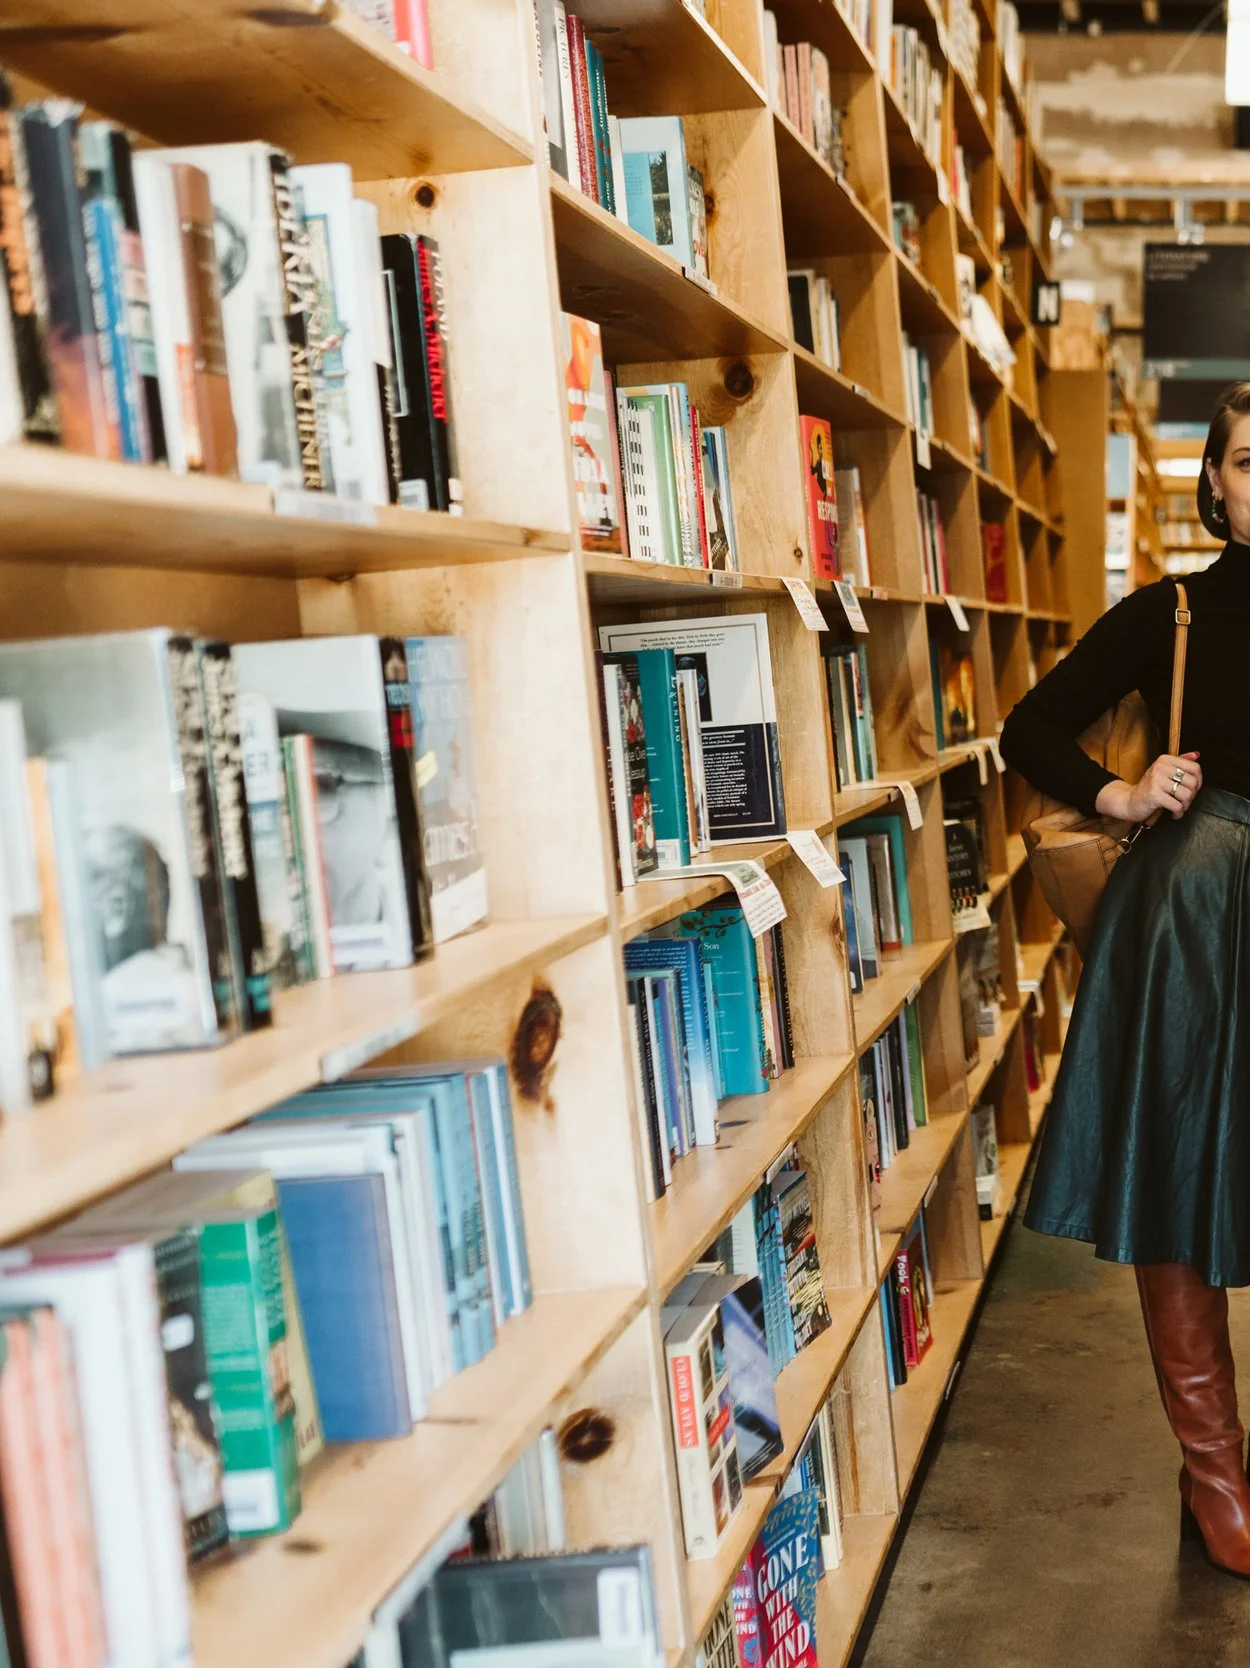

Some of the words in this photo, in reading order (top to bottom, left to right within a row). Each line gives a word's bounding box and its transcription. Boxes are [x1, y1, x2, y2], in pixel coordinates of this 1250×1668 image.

[555, 17, 574, 79] PICTURES
[590, 68, 609, 130] Monogamy
[422, 305, 439, 328] A.
[429, 251, 452, 342] POLAND
[1039, 287, 1058, 321] N
[422, 330, 452, 425] Michener
[286, 342, 324, 490] MICHENER
[703, 942, 720, 950] Son
[674, 1357, 693, 1403] CLOUD
[680, 1408, 698, 1448] ATLAS
[757, 1531, 809, 1604] GONE
[765, 1575, 798, 1622] WITH
[766, 1620, 810, 1668] WIND
[771, 1605, 795, 1645] THE
